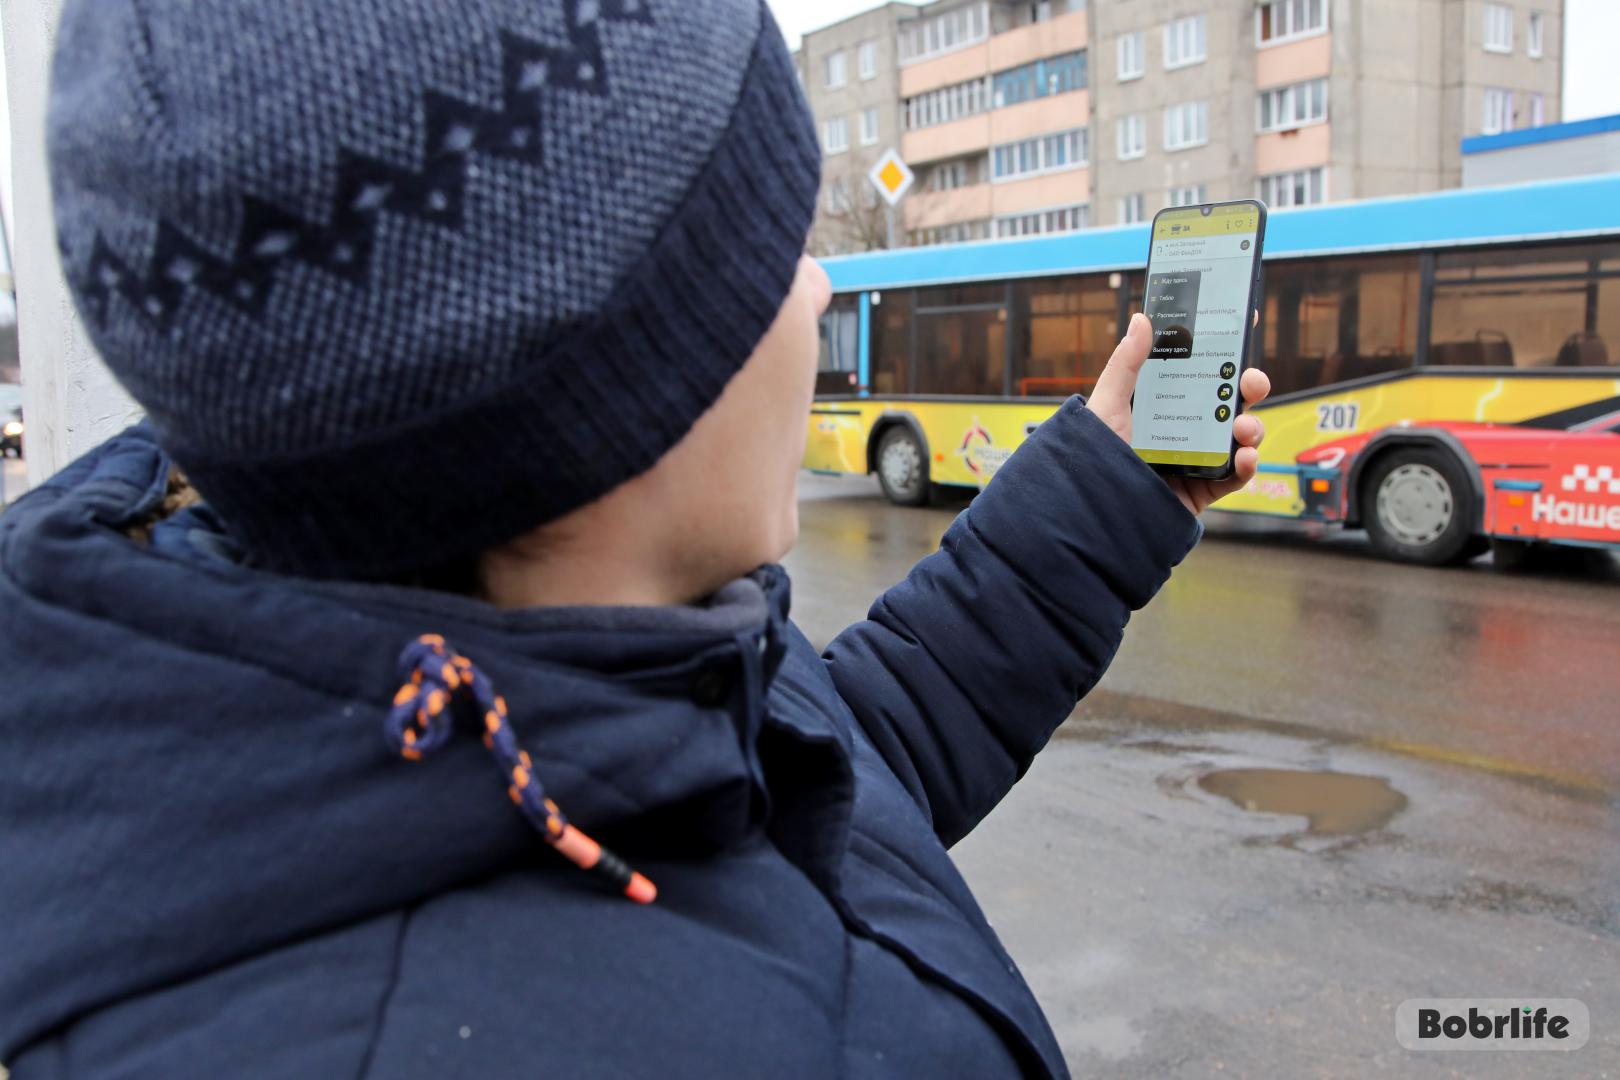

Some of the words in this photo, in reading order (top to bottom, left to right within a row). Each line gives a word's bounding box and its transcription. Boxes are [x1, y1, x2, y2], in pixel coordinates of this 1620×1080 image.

[1205, 350, 1235, 358] больница
[1152, 413, 1176, 421] Дворец
[1318, 403, 1358, 431] 207
[1151, 434, 1189, 442] Ульяновская
